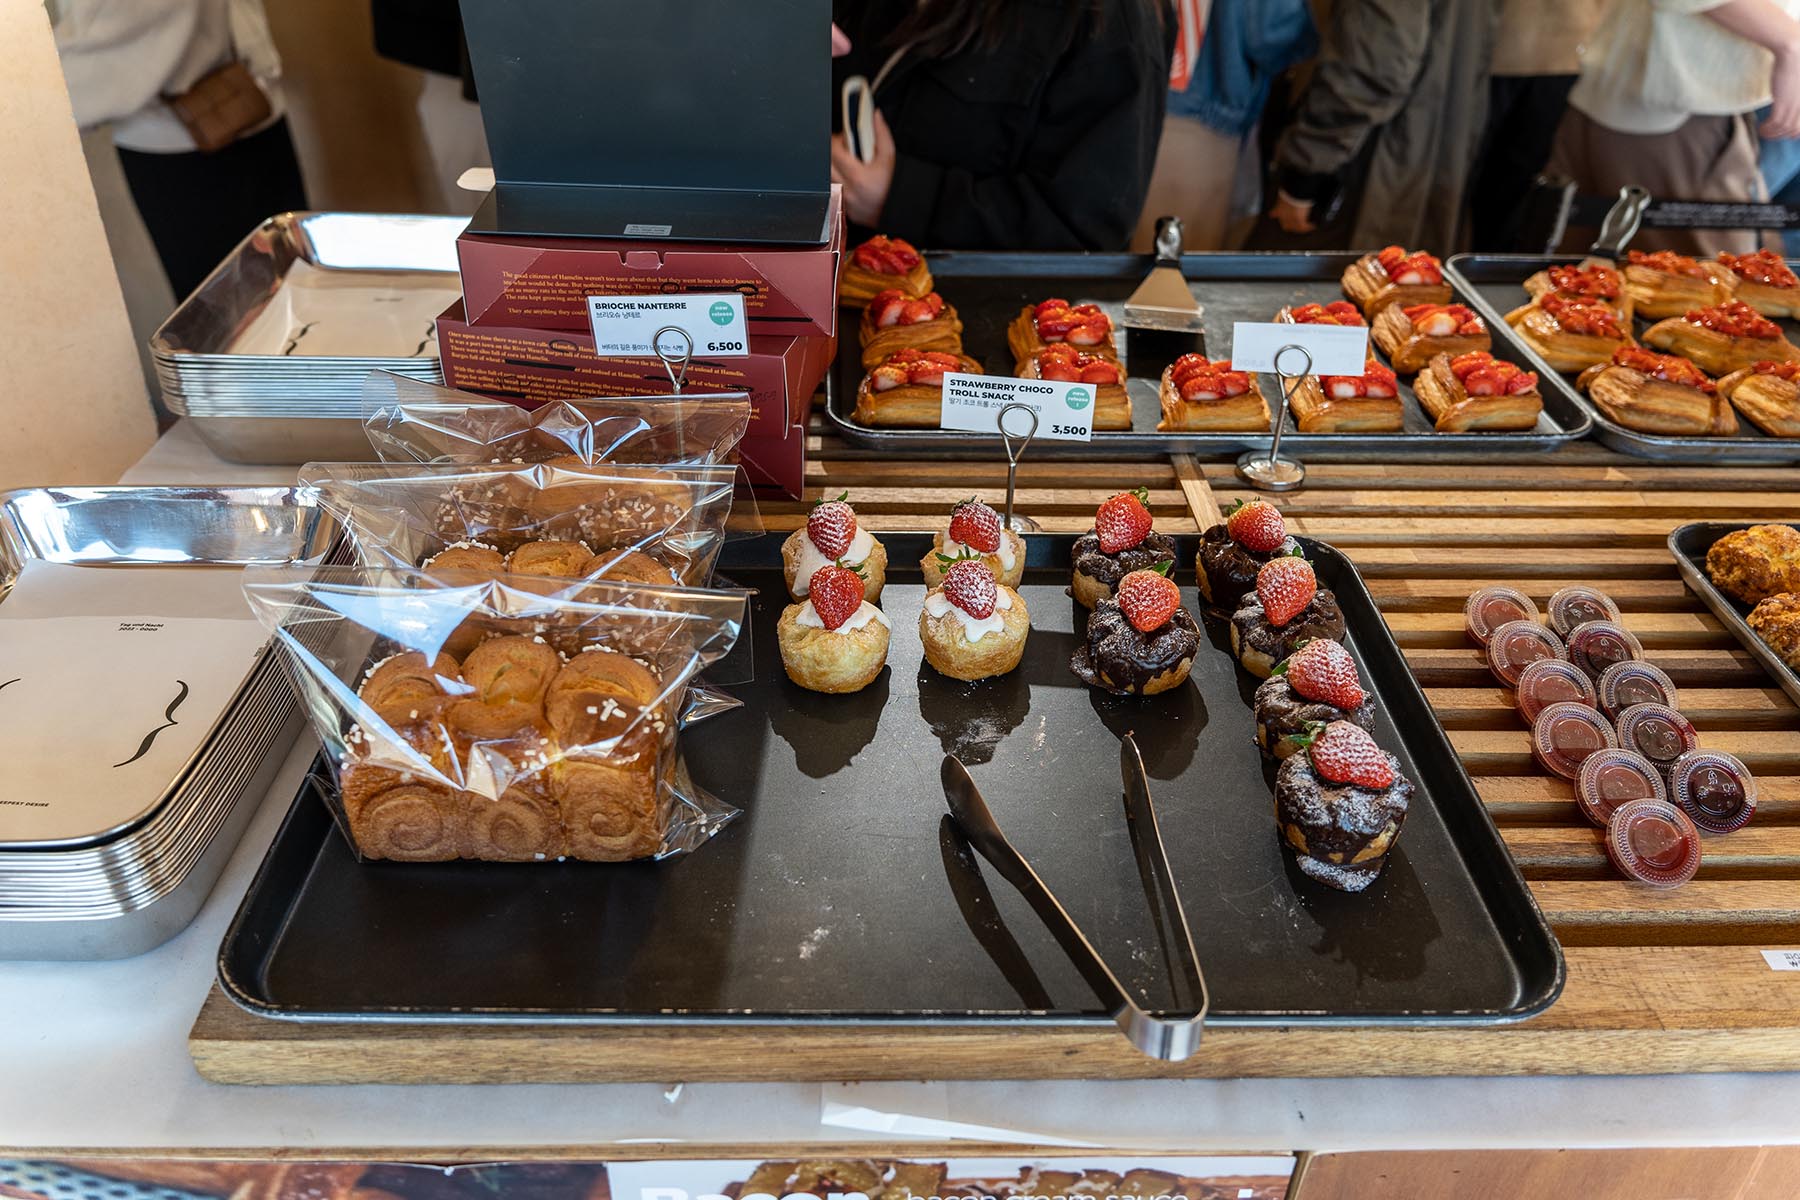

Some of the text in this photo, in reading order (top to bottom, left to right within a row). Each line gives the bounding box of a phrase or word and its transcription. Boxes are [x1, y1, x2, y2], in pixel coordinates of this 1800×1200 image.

[638, 302, 687, 310] NANTERRE
[596, 312, 621, 320] 브리오슈
[650, 344, 672, 352] 느지는
[708, 342, 742, 352] 6,500
[452, 352, 468, 361] Barges
[694, 366, 713, 374] unload
[950, 378, 1054, 395] STRAWBERRY CHOCO
[950, 388, 1014, 402] TROLL SNACK
[948, 397, 962, 406] 딸기
[962, 398, 976, 407] 초코
[1052, 424, 1087, 436] 3,500
